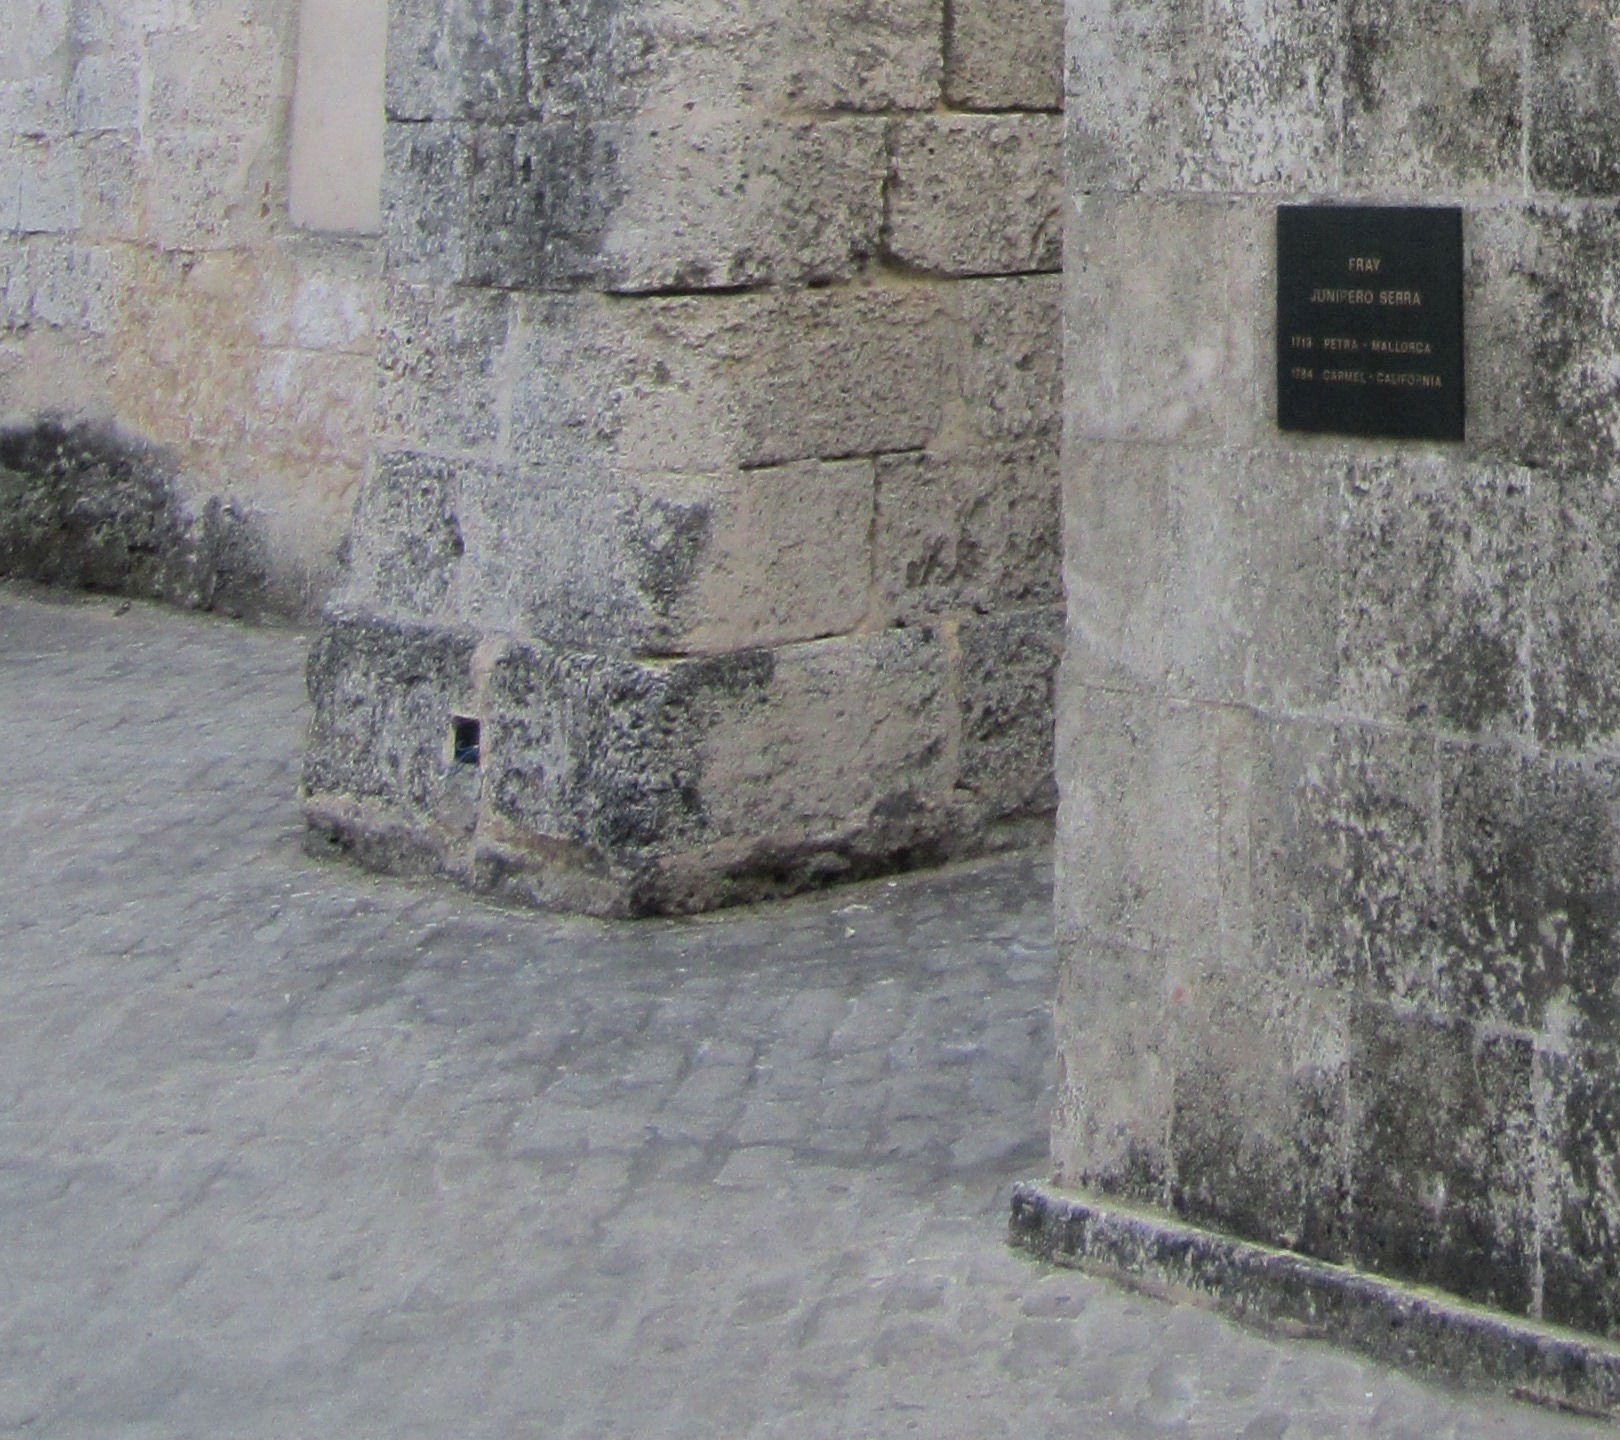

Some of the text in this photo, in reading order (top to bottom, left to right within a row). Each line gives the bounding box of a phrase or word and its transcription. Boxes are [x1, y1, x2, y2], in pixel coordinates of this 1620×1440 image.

[1349, 258, 1381, 272] FRAY
[1379, 290, 1421, 305] SERRA
[1291, 336, 1312, 348] 1713
[1324, 338, 1358, 351] PETRA
[1371, 339, 1431, 354] MALLORCA
[1322, 369, 1367, 384] CARMEL
[1375, 372, 1442, 388] CALIFORNIA
